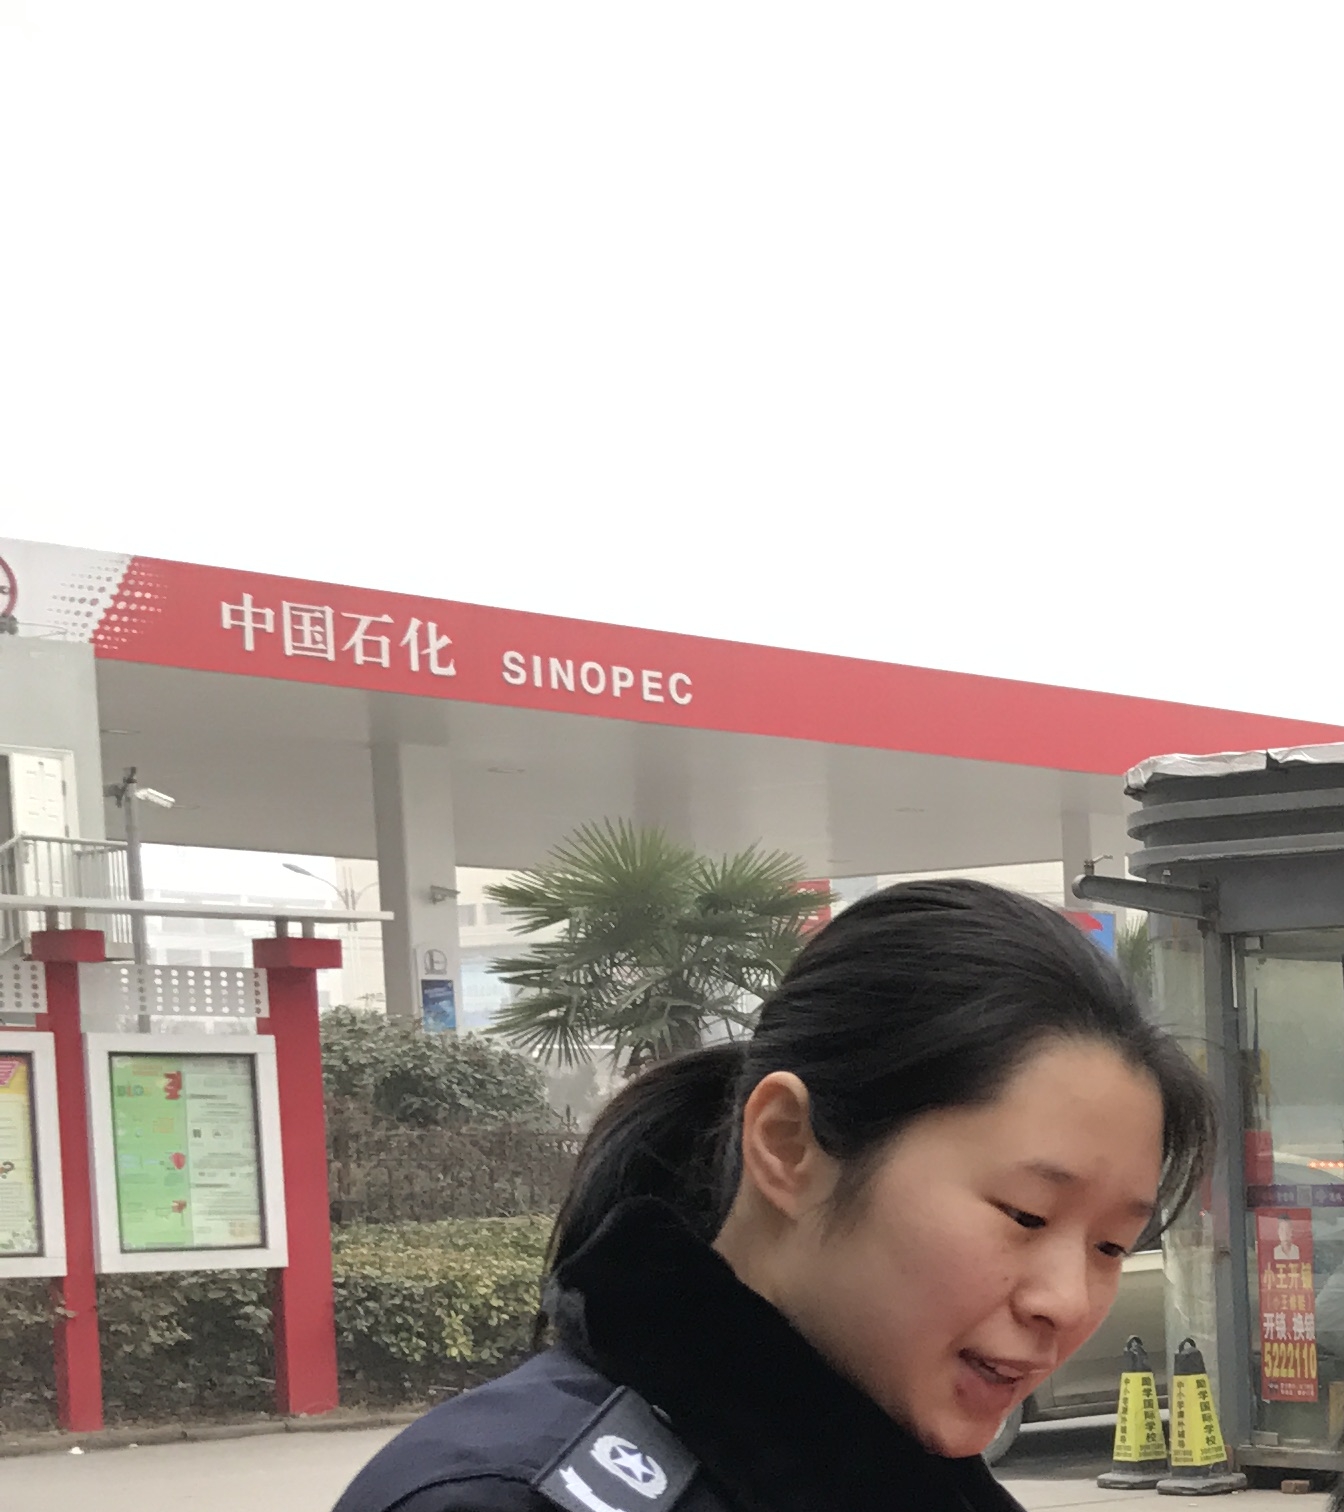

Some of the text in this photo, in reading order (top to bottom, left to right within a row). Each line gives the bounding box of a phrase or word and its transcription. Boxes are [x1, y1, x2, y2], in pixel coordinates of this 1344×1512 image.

[220, 592, 458, 677] 中国石化
[501, 650, 694, 706] SINOPEC
[1264, 1342, 1317, 1379] 5222110
